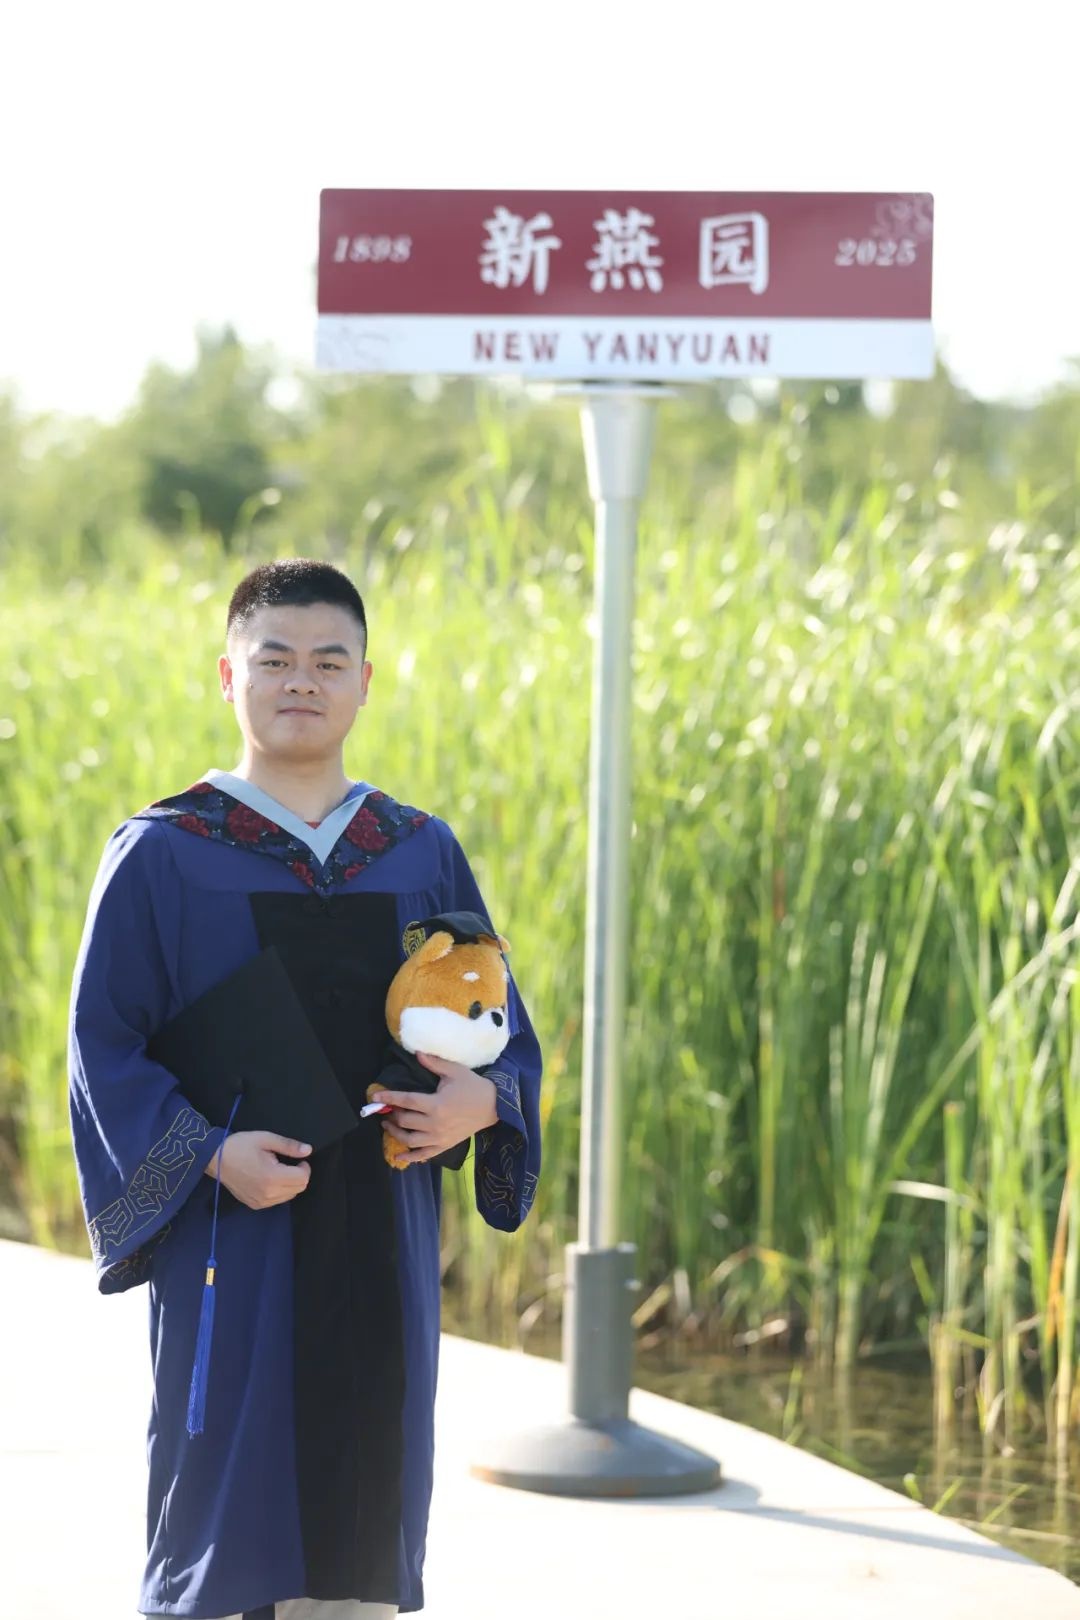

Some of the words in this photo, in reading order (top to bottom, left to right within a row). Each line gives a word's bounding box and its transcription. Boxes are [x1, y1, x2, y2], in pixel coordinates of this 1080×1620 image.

[333, 236, 412, 263] 1898
[479, 206, 770, 295] 新燕园
[835, 239, 917, 267] 2025
[474, 331, 559, 362] NEW
[584, 332, 772, 365] YANYUAN
